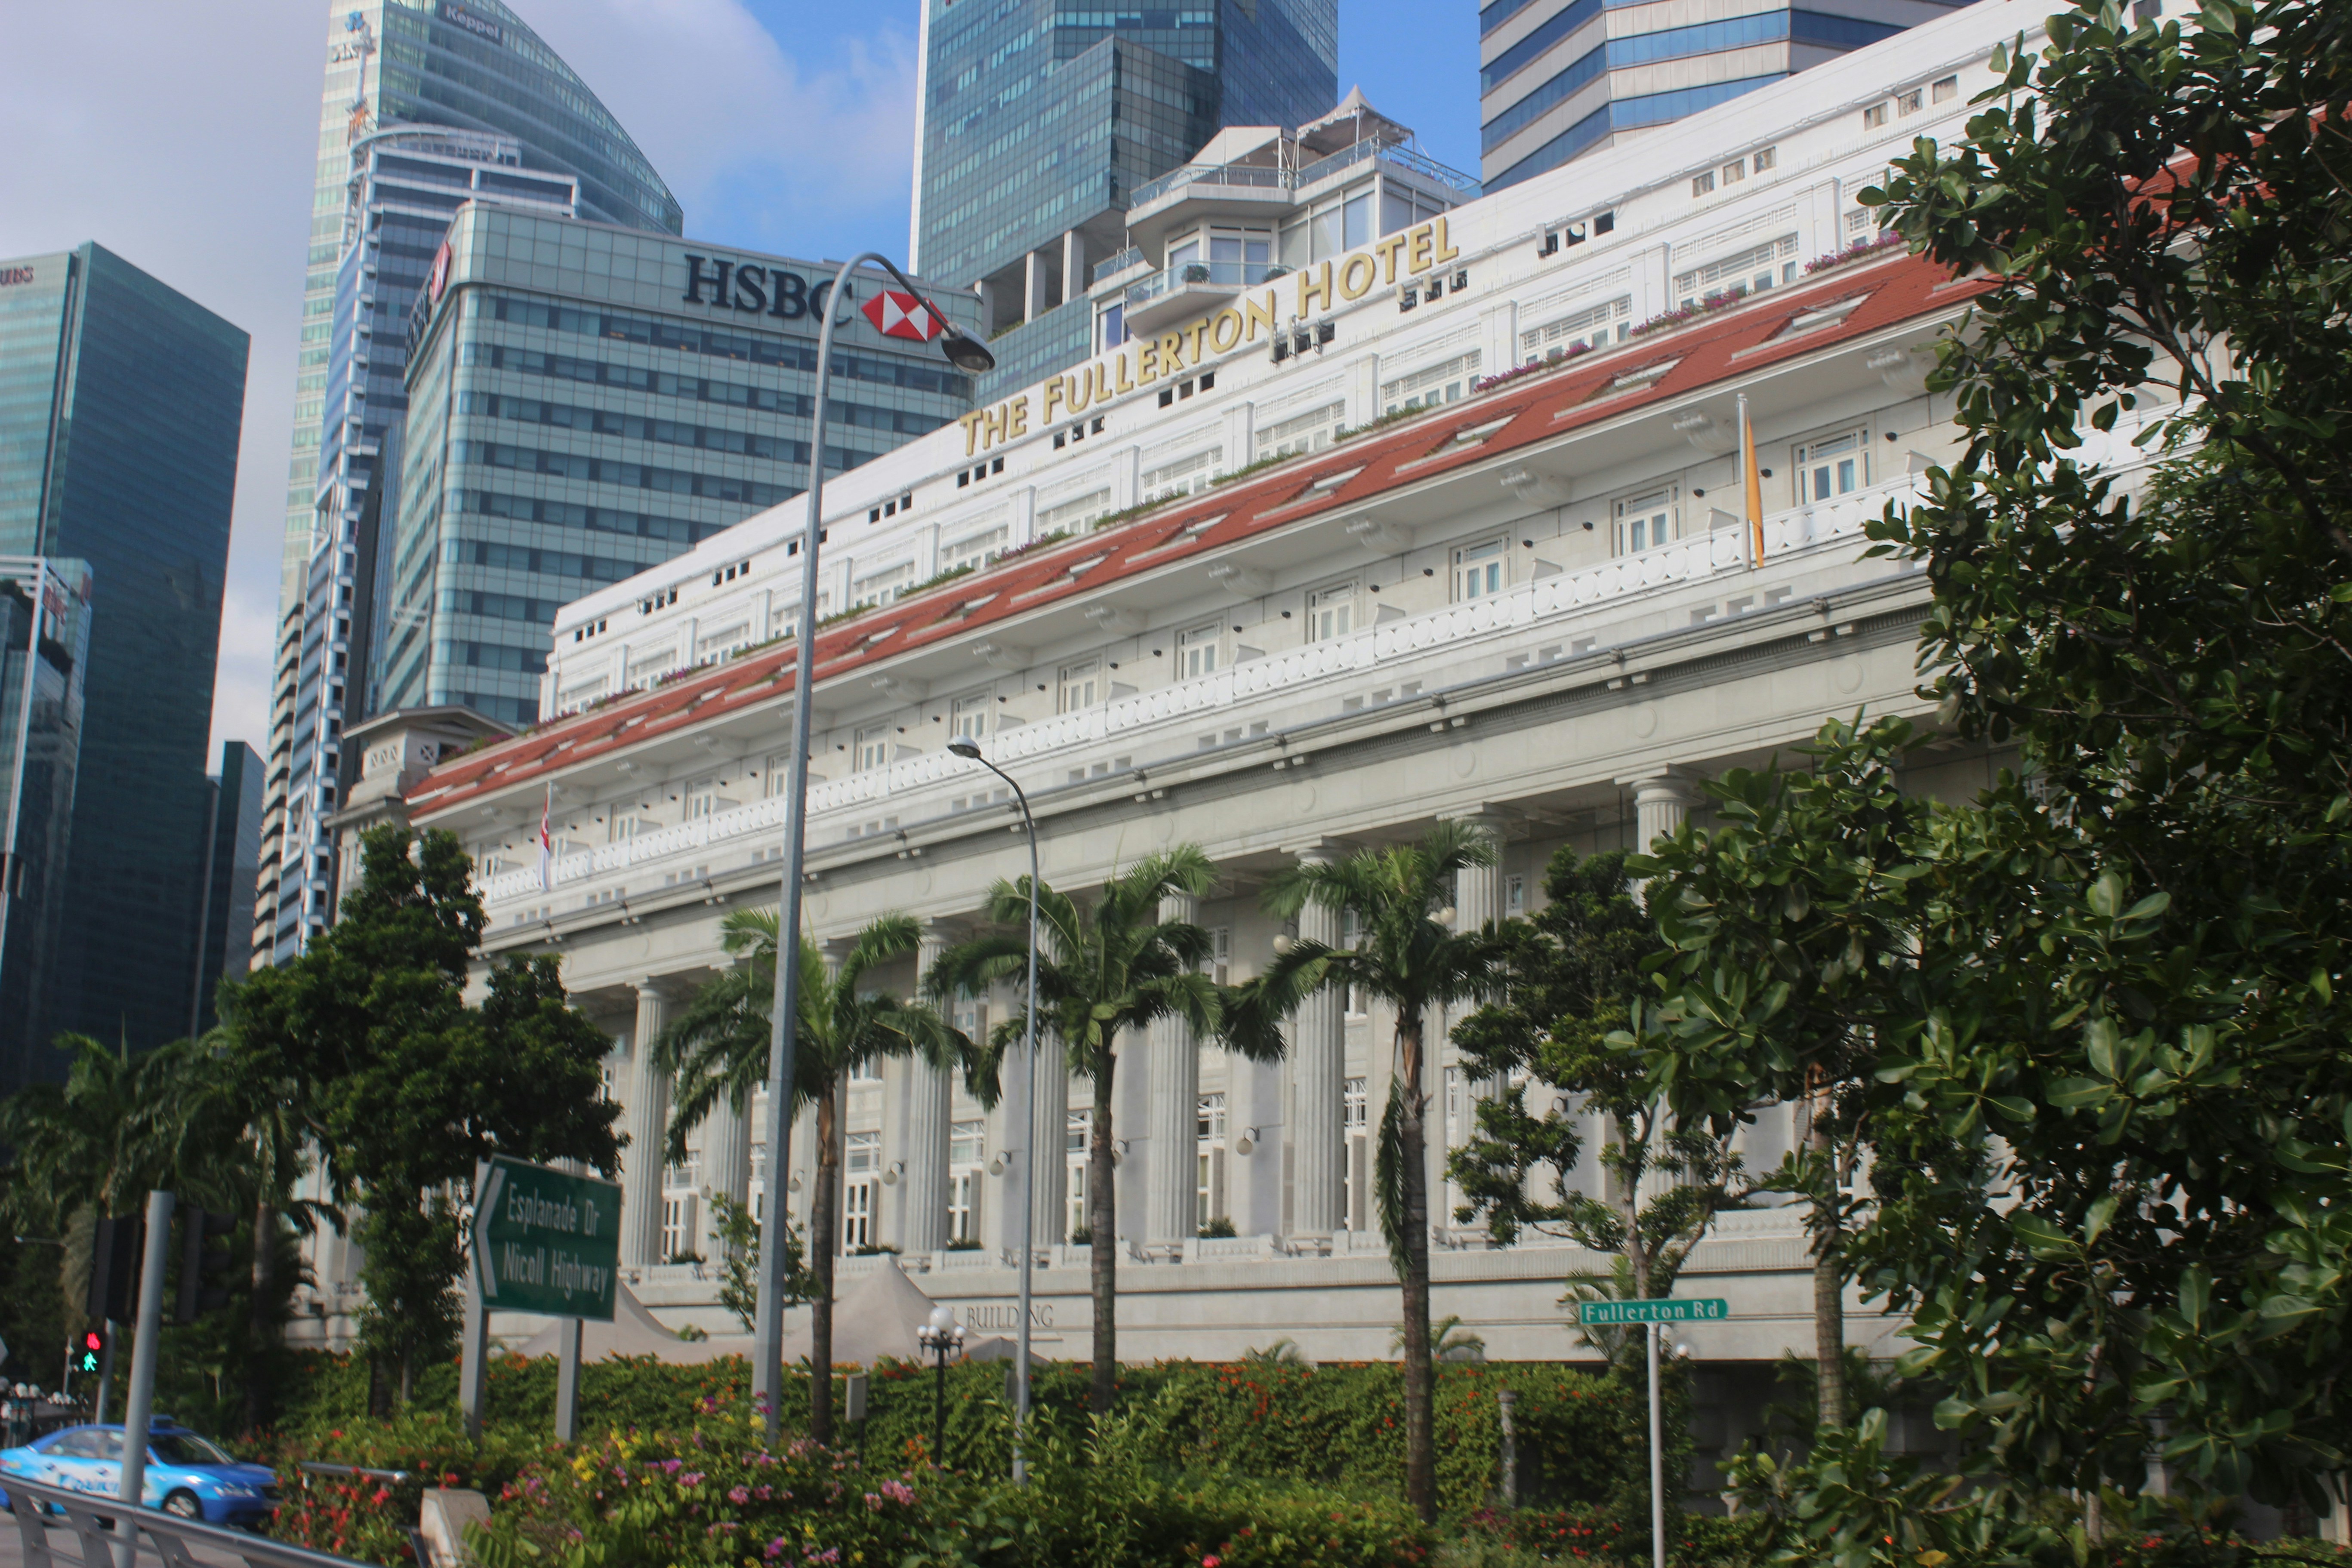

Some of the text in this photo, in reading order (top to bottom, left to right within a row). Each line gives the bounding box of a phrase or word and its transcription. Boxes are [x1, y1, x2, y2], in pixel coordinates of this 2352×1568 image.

[446, 4, 500, 40] Keppel
[682, 254, 853, 327] HSBC
[959, 216, 1460, 456] THE FULLERTON HOTEL
[507, 1181, 600, 1237] Esplanade Dr
[502, 1241, 608, 1303] Nicoll Highway
[967, 1304, 1054, 1328] BUILDNG
[1585, 1300, 1719, 1322] Fullerton Rd
